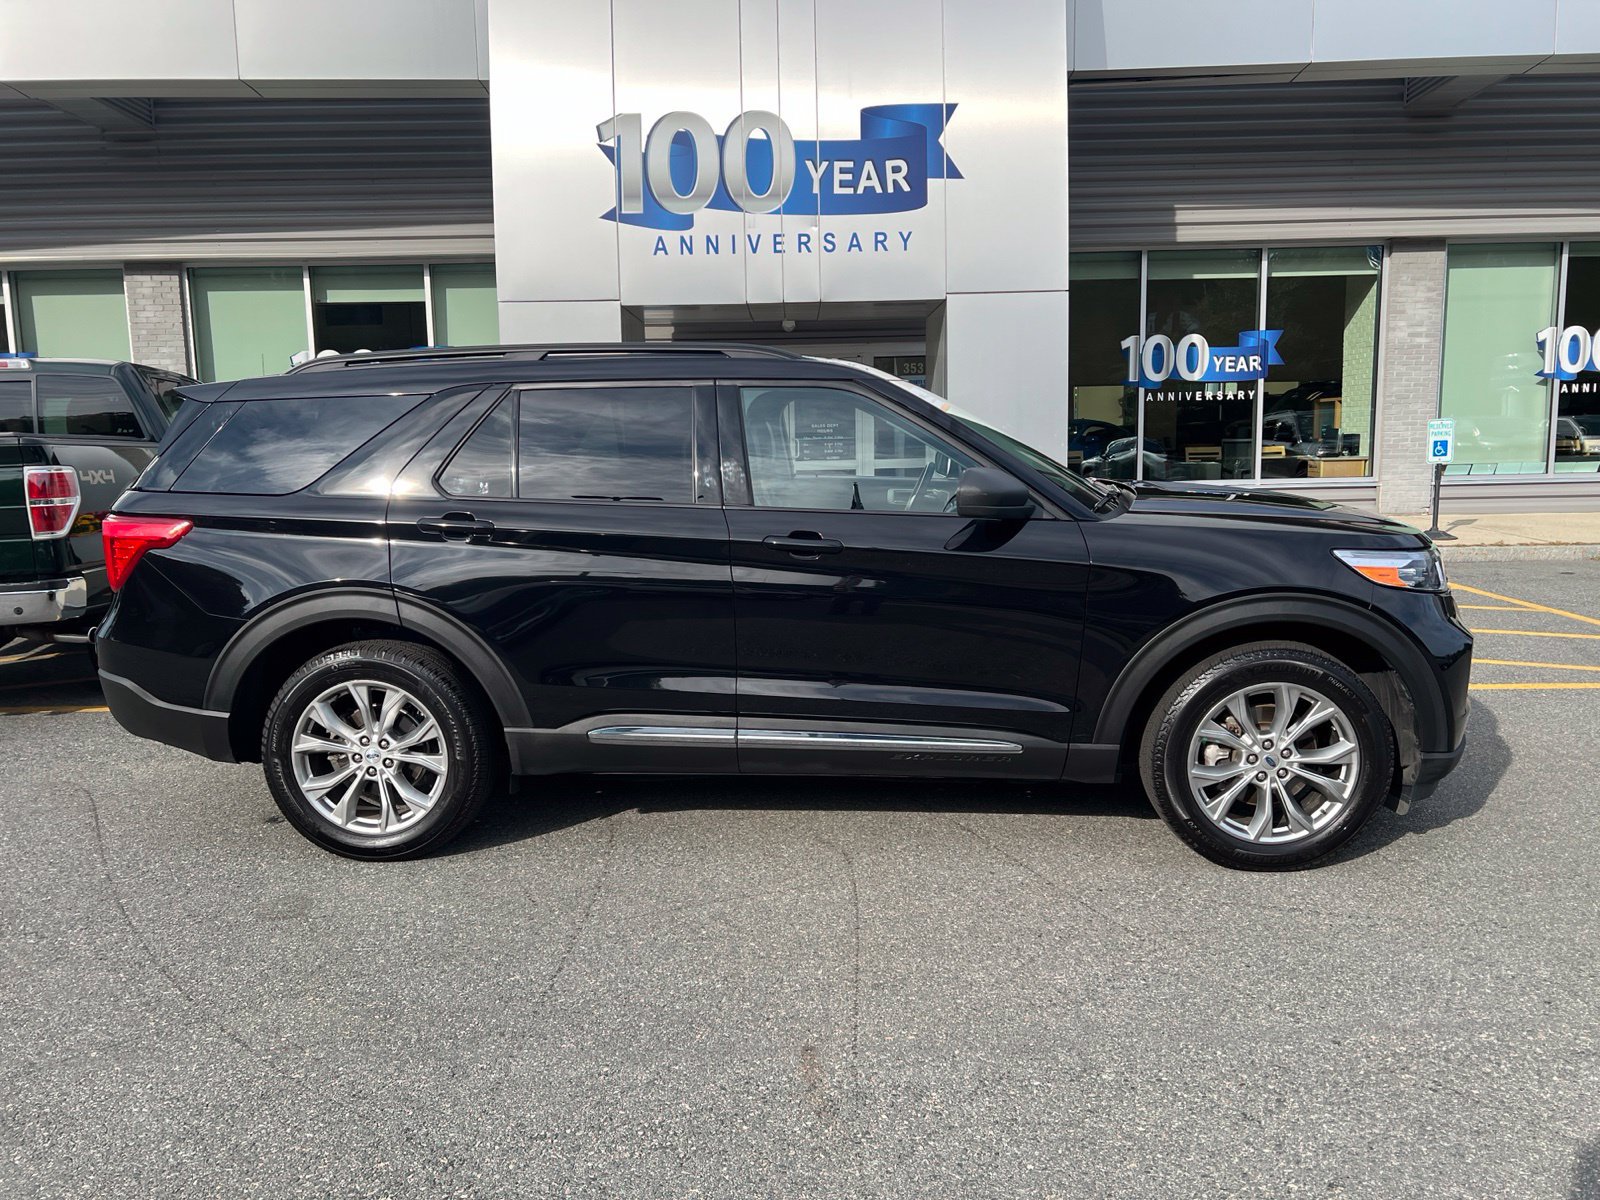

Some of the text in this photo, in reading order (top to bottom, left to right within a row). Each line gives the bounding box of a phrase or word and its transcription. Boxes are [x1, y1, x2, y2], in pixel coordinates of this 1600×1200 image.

[596, 110, 912, 214] 100 YEAR
[653, 231, 914, 256] ANNIVERSARY
[903, 362, 924, 374] 353
[1120, 333, 1262, 382] 100 YEAR
[1536, 325, 1600, 374] 10
[1146, 390, 1255, 402] ANNIVERSARY
